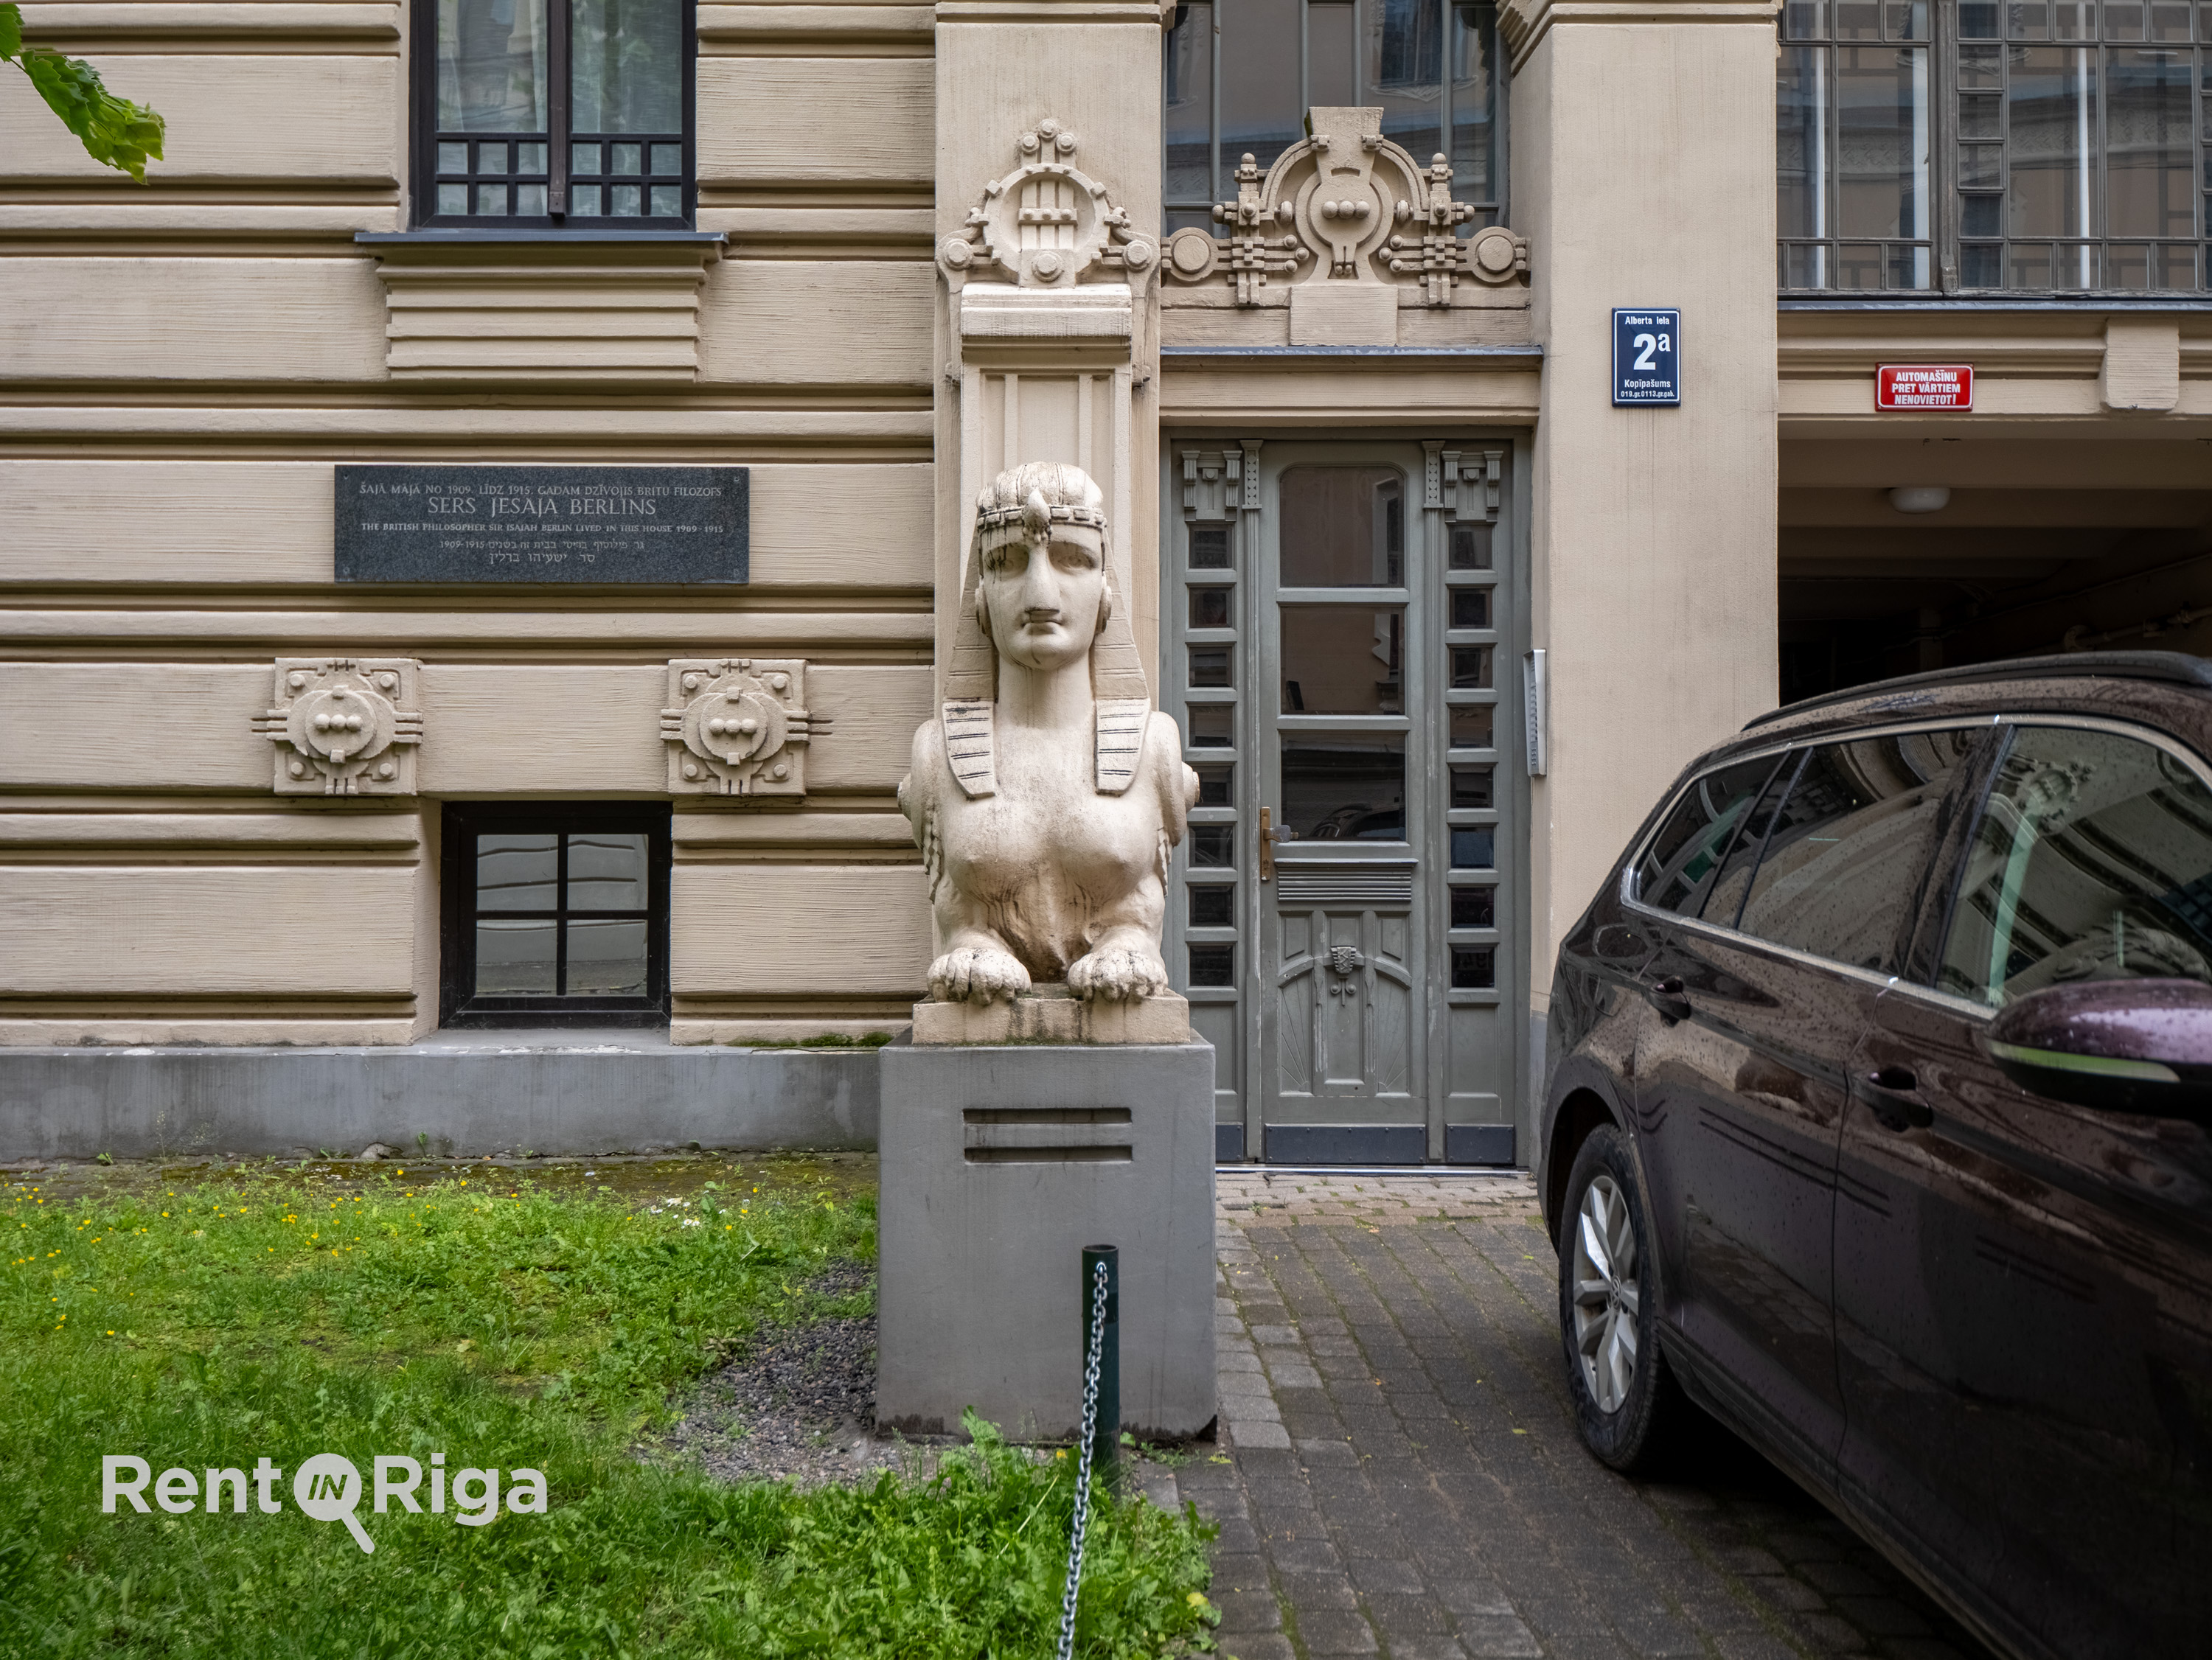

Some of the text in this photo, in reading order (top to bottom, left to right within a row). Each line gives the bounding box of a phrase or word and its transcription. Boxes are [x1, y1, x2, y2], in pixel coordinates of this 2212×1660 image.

[1625, 316, 1669, 324] Alberta iela
[1896, 369, 1957, 382] AUTOMAŠĪNU
[1624, 379, 1671, 389] Kopīpašums
[1891, 382, 1961, 393] PRET VĀRTIEM
[1894, 394, 1956, 405] NENOVIETOT!
[360, 481, 722, 497] ŠAJĀ MĀJĀ NO 1909. LĪDZ 1915. GADAM DZĪVOJIS BRITU FILOZOFS
[428, 496, 655, 517] SERS JESAJA BERLINS
[488, 540, 517, 548] בשנים
[594, 538, 627, 551] פילוסוף
[490, 551, 595, 565] סר ישעיהו ברלין
